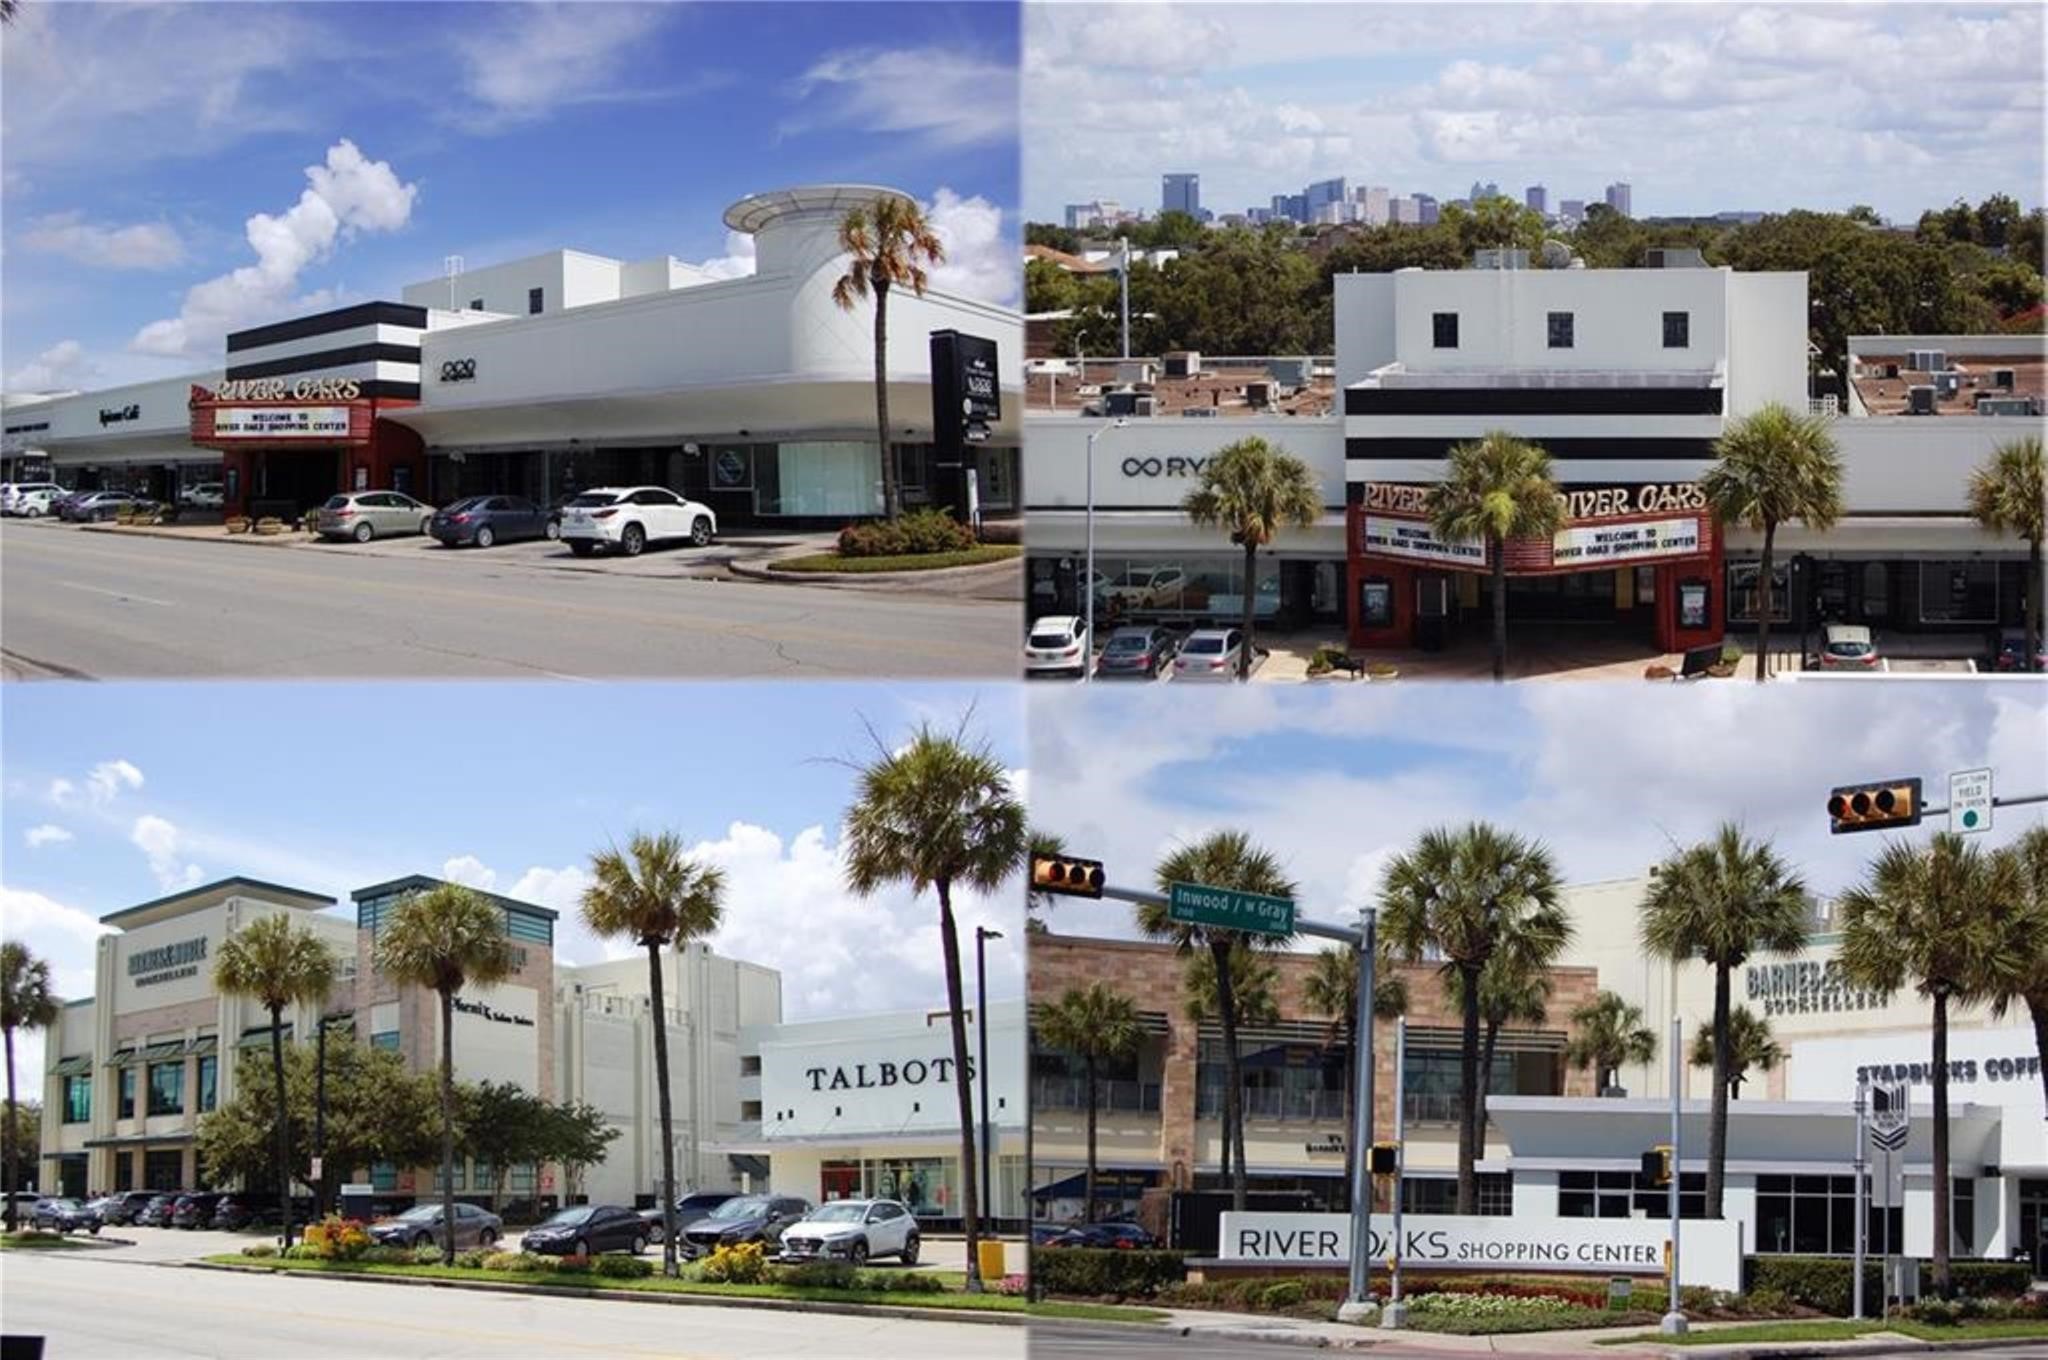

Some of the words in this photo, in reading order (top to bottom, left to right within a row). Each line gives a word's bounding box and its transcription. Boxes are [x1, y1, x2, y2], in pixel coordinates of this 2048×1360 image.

[214, 379, 285, 400] RIVER
[292, 378, 361, 400] OAKS
[252, 413, 291, 422] WELCOME
[313, 422, 346, 431] CENTER
[1363, 482, 1426, 511] RIVER
[1638, 484, 1706, 513] OAKS
[1555, 547, 1582, 558] RIVER
[1586, 545, 1609, 555] OAKS
[1613, 540, 1658, 554] SHOPPING
[1661, 536, 1696, 549] CENTER
[1594, 530, 1638, 543] WELCOME
[1646, 529, 1657, 538] TO
[1177, 888, 1229, 911] Inwood
[1259, 901, 1288, 922] Gray
[806, 1056, 976, 1091] TALBOTS
[1857, 1059, 1978, 1085] STARBUKS
[1239, 1229, 1339, 1257] RIVER
[1457, 1242, 1569, 1261] SHOPPING
[1577, 1243, 1657, 1263] CENTER
